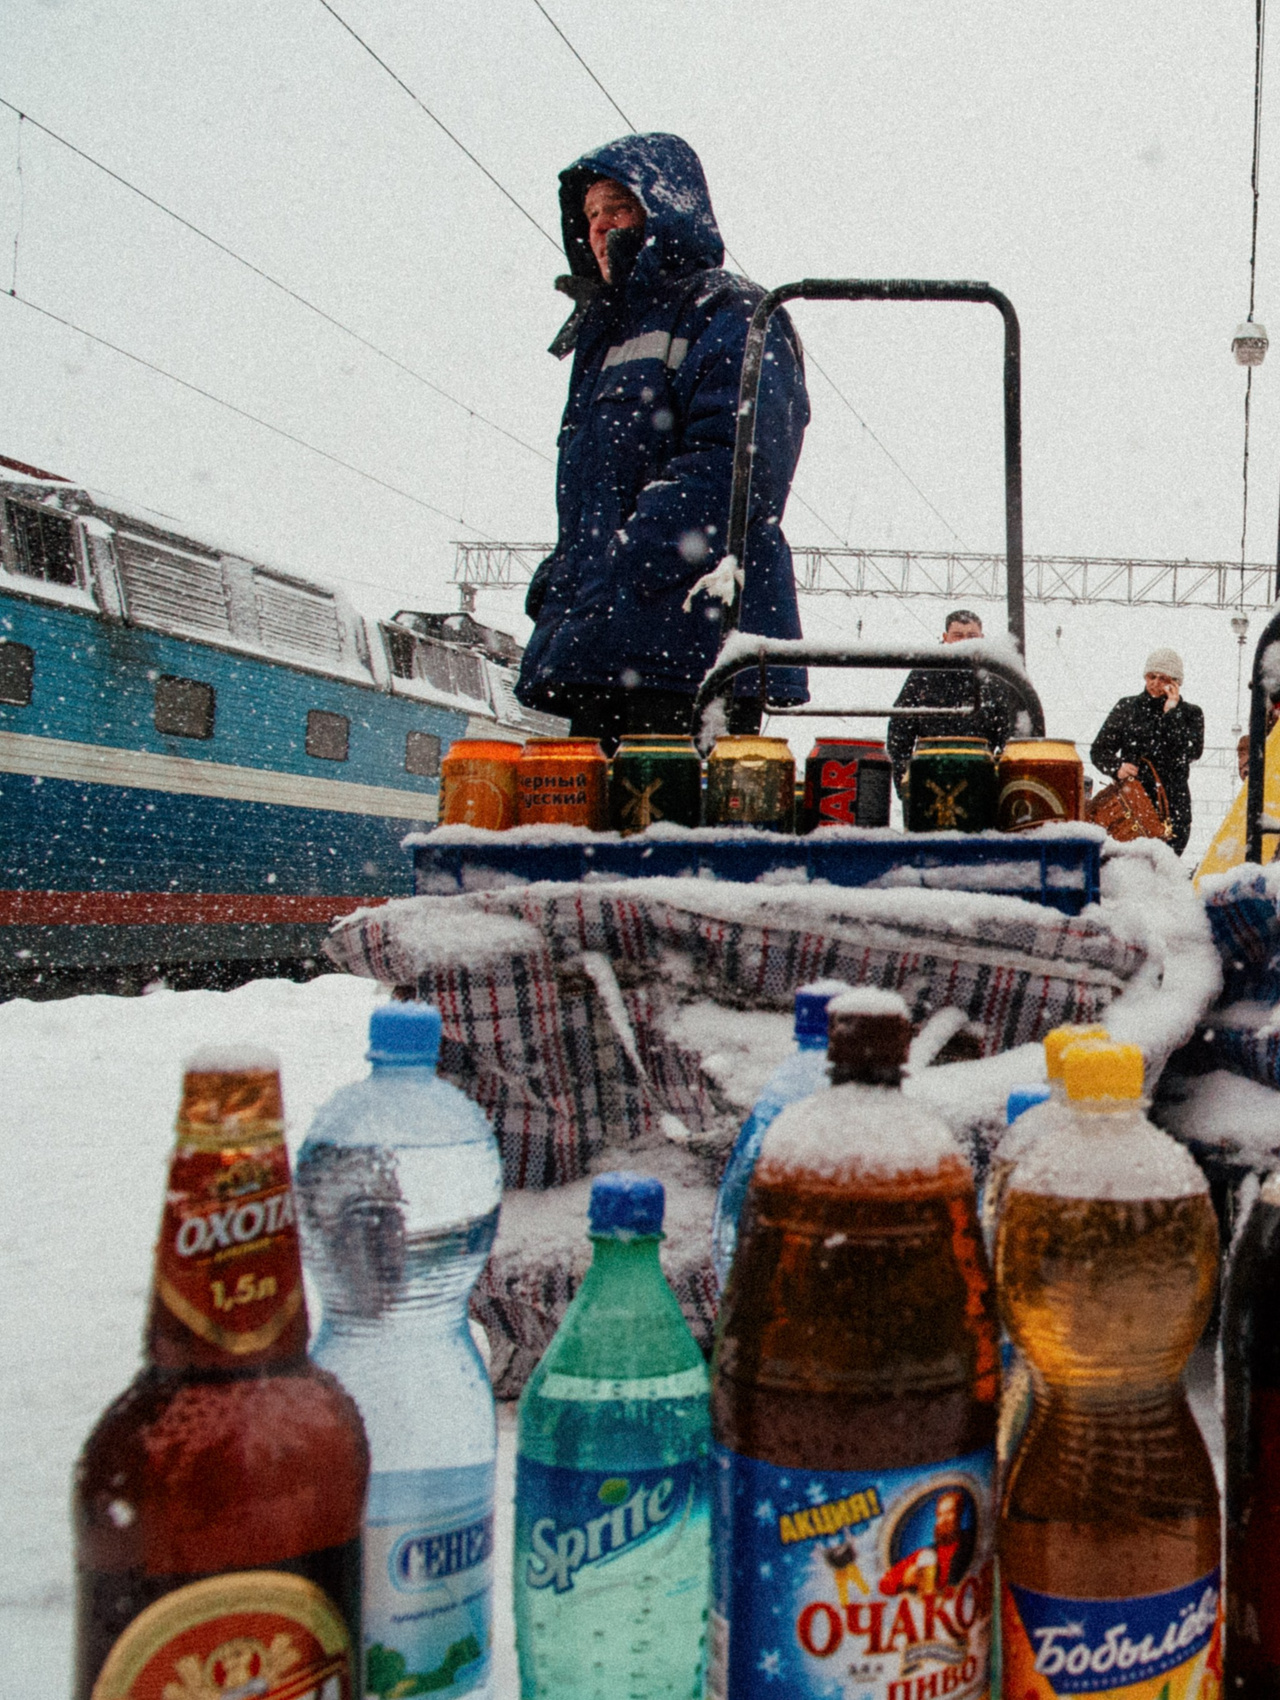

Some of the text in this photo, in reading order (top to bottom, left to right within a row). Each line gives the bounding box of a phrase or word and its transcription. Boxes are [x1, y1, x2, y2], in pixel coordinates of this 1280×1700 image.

[818, 760, 858, 827] AR
[176, 1191, 295, 1257] ОХОТА
[527, 1477, 674, 1593] Sprite
[779, 1488, 881, 1544] АКЦИЯ!
